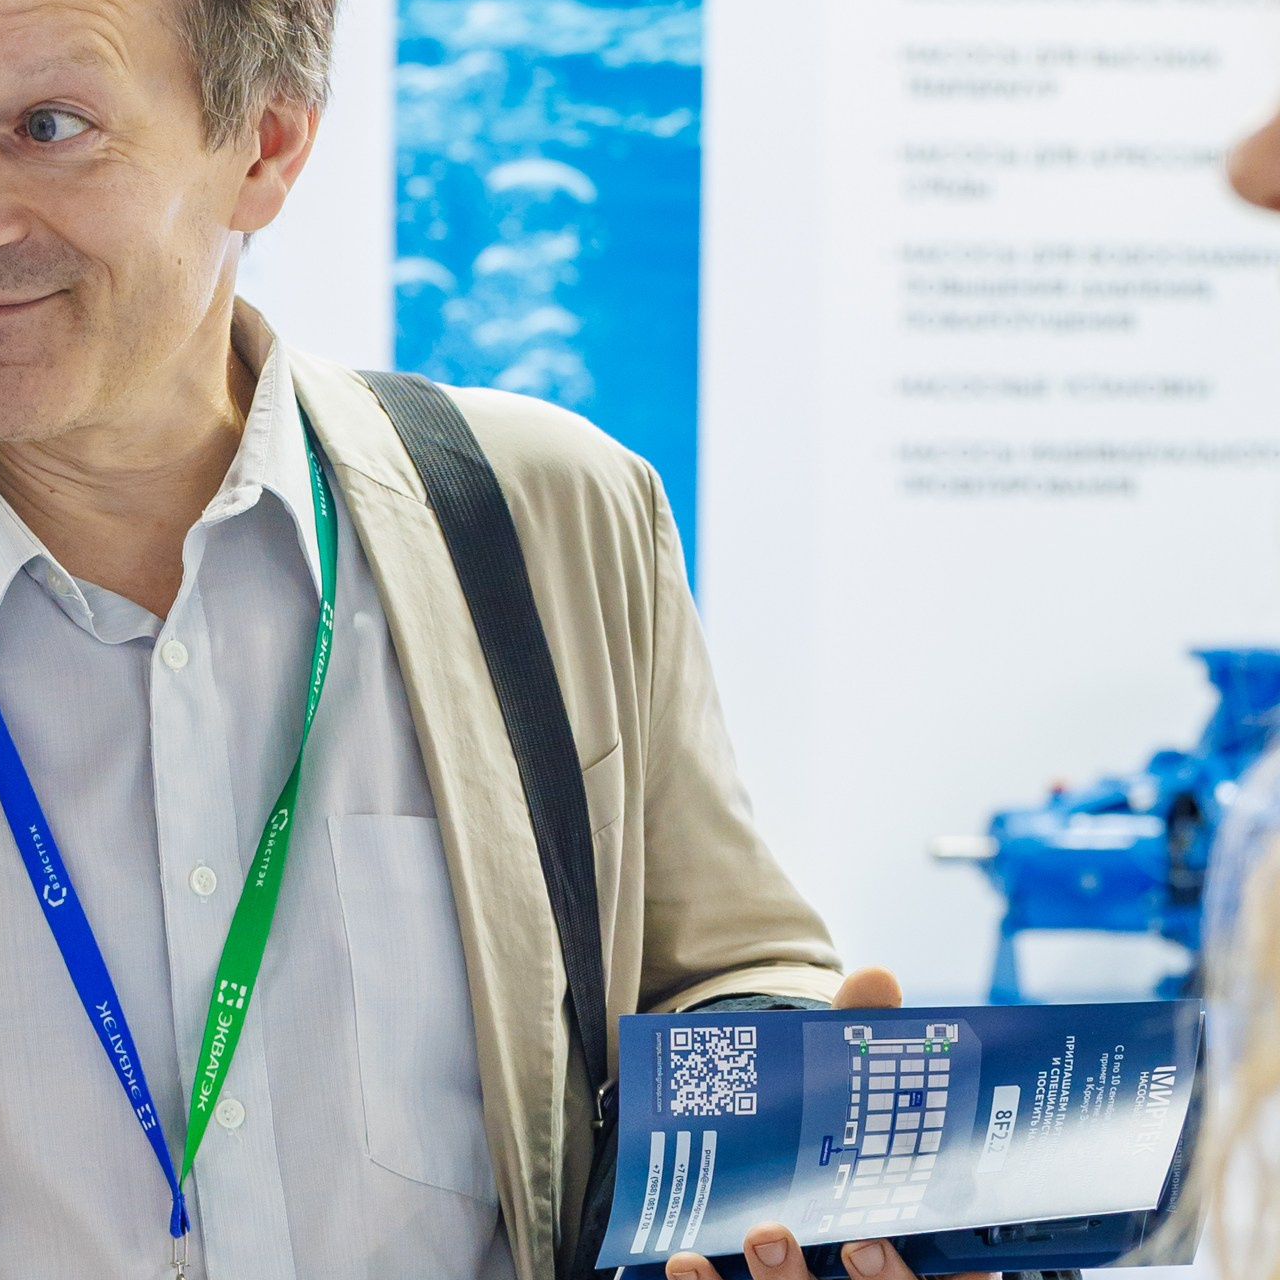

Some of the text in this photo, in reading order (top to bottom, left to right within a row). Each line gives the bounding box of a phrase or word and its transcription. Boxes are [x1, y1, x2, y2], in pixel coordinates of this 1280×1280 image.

[96, 1000, 142, 1098] ЭКВАТЭК
[196, 1010, 233, 1112] ЭКВАТЭК
[655, 1032, 663, 1113] pumps.mirtekgroup.com
[1052, 1057, 1061, 1066] И
[1098, 1053, 1108, 1085] примет
[1112, 1062, 1122, 1073] по
[1059, 1035, 1075, 1112] ПРИГЛАШАЕМ
[1111, 1075, 1121, 1085] 10
[1030, 1071, 1047, 1127] ПОСЕТИТЬ
[651, 1163, 659, 1175] +7
[675, 1163, 686, 1174] +7
[646, 1197, 656, 1211] 085
[669, 1196, 680, 1210] 085
[687, 1149, 712, 1237] pumps@mirtekgroup.ru
